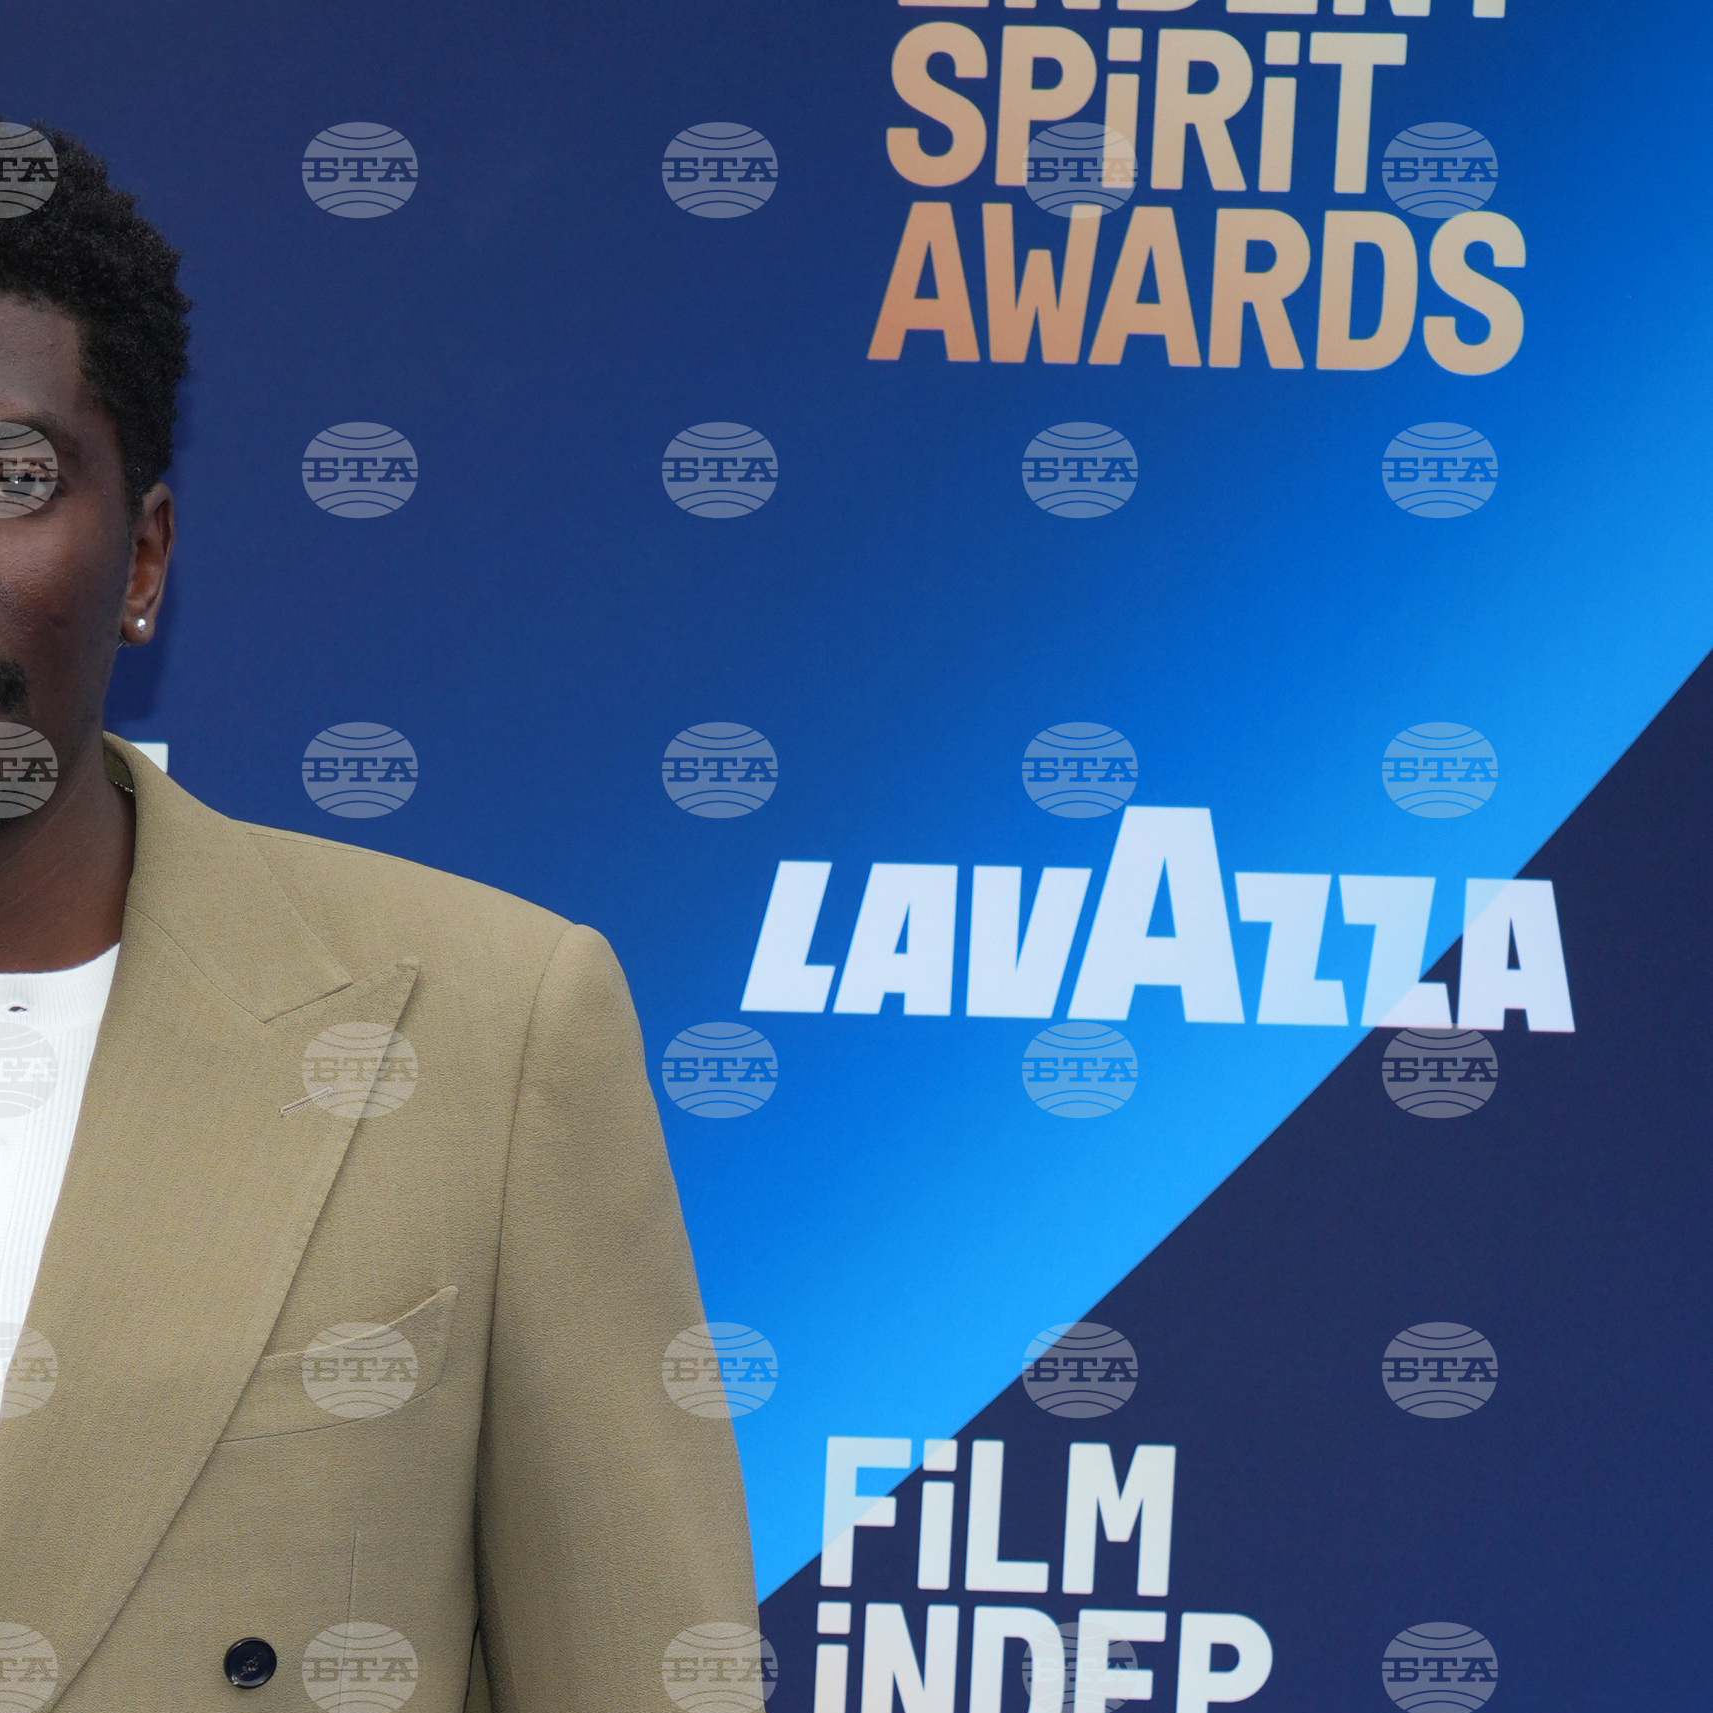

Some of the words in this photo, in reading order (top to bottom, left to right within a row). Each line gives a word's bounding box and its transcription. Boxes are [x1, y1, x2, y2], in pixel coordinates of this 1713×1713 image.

[886, 21, 1407, 194] SPiRiT
[867, 201, 1526, 375] AWARDS
[740, 805, 1575, 1032] LAVAZZA
[819, 1436, 1176, 1597] FiLM
